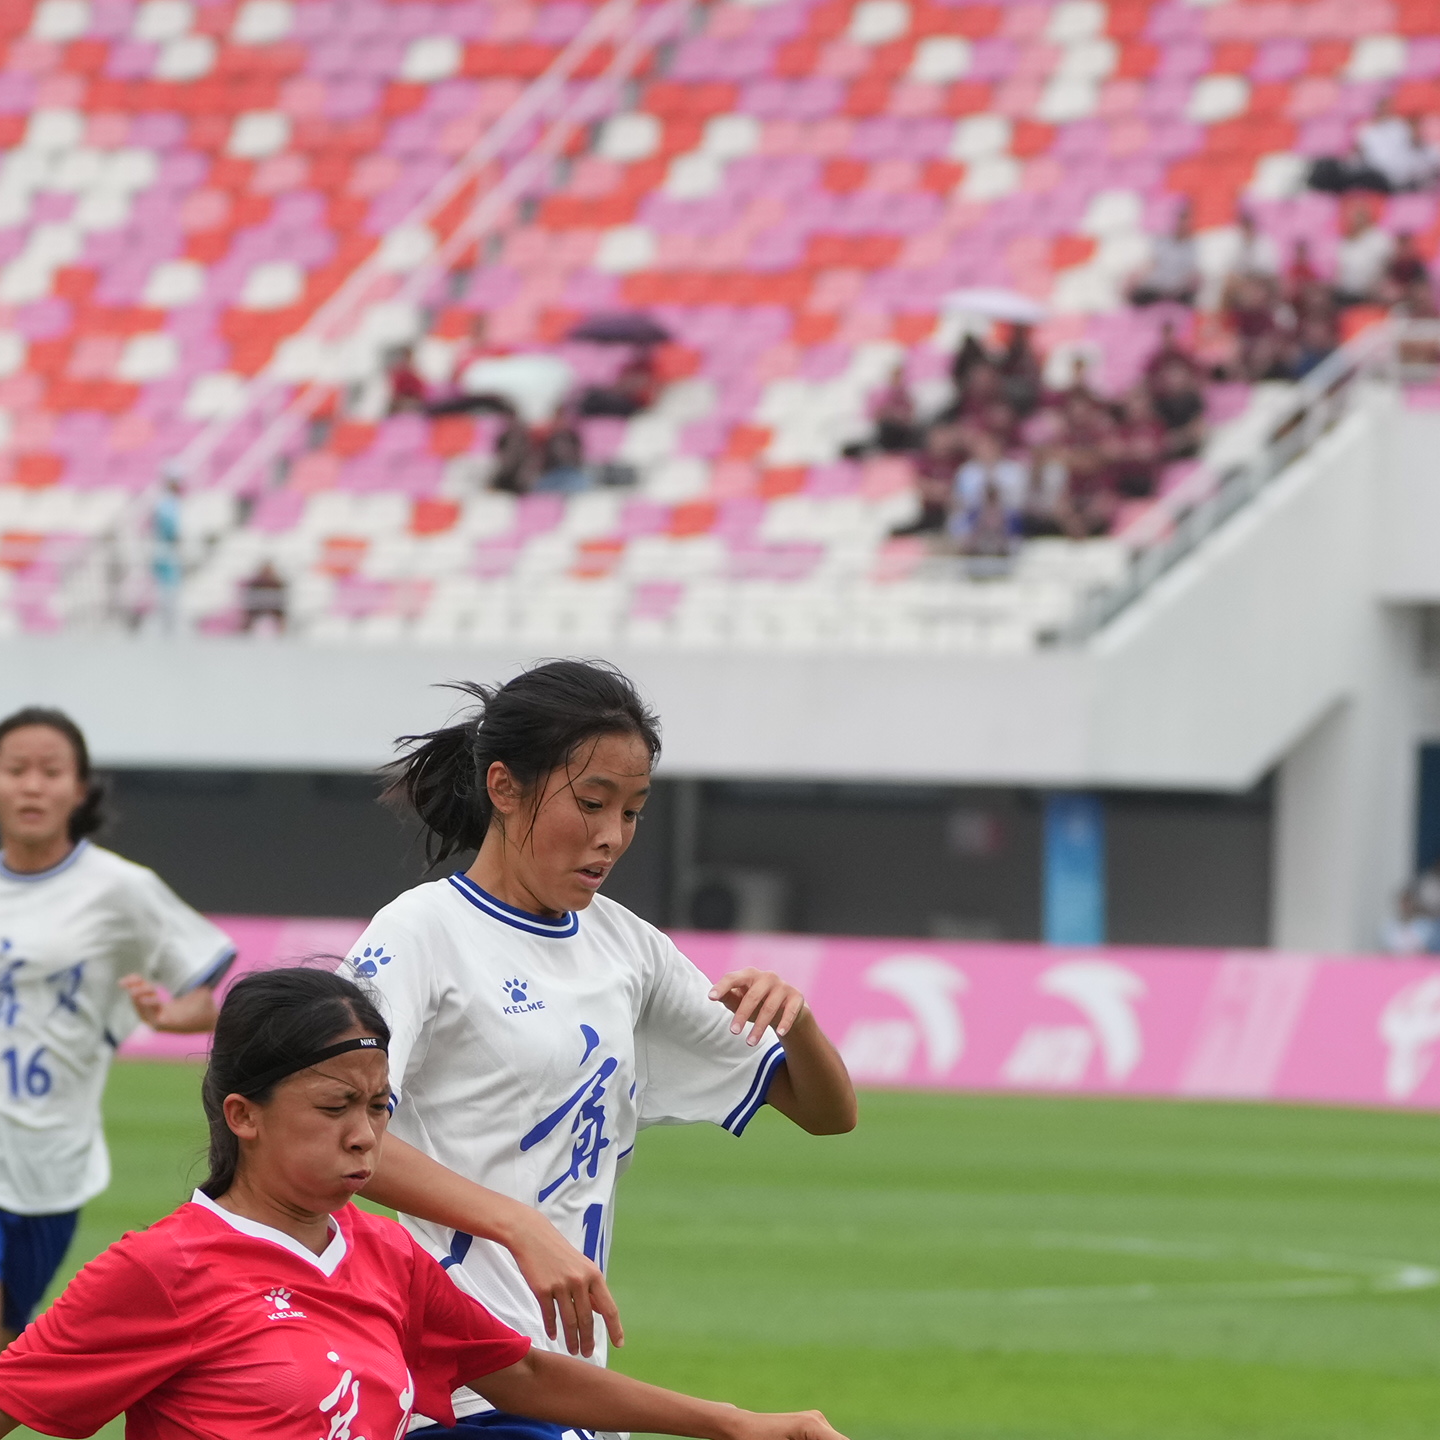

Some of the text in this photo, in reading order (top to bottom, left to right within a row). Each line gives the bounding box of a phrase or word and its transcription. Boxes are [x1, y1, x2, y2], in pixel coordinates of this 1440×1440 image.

[503, 1001, 545, 1014] KELME
[360, 1038, 377, 1046] NIKE
[1, 1046, 51, 1099] 16
[267, 1311, 308, 1320] KELME
